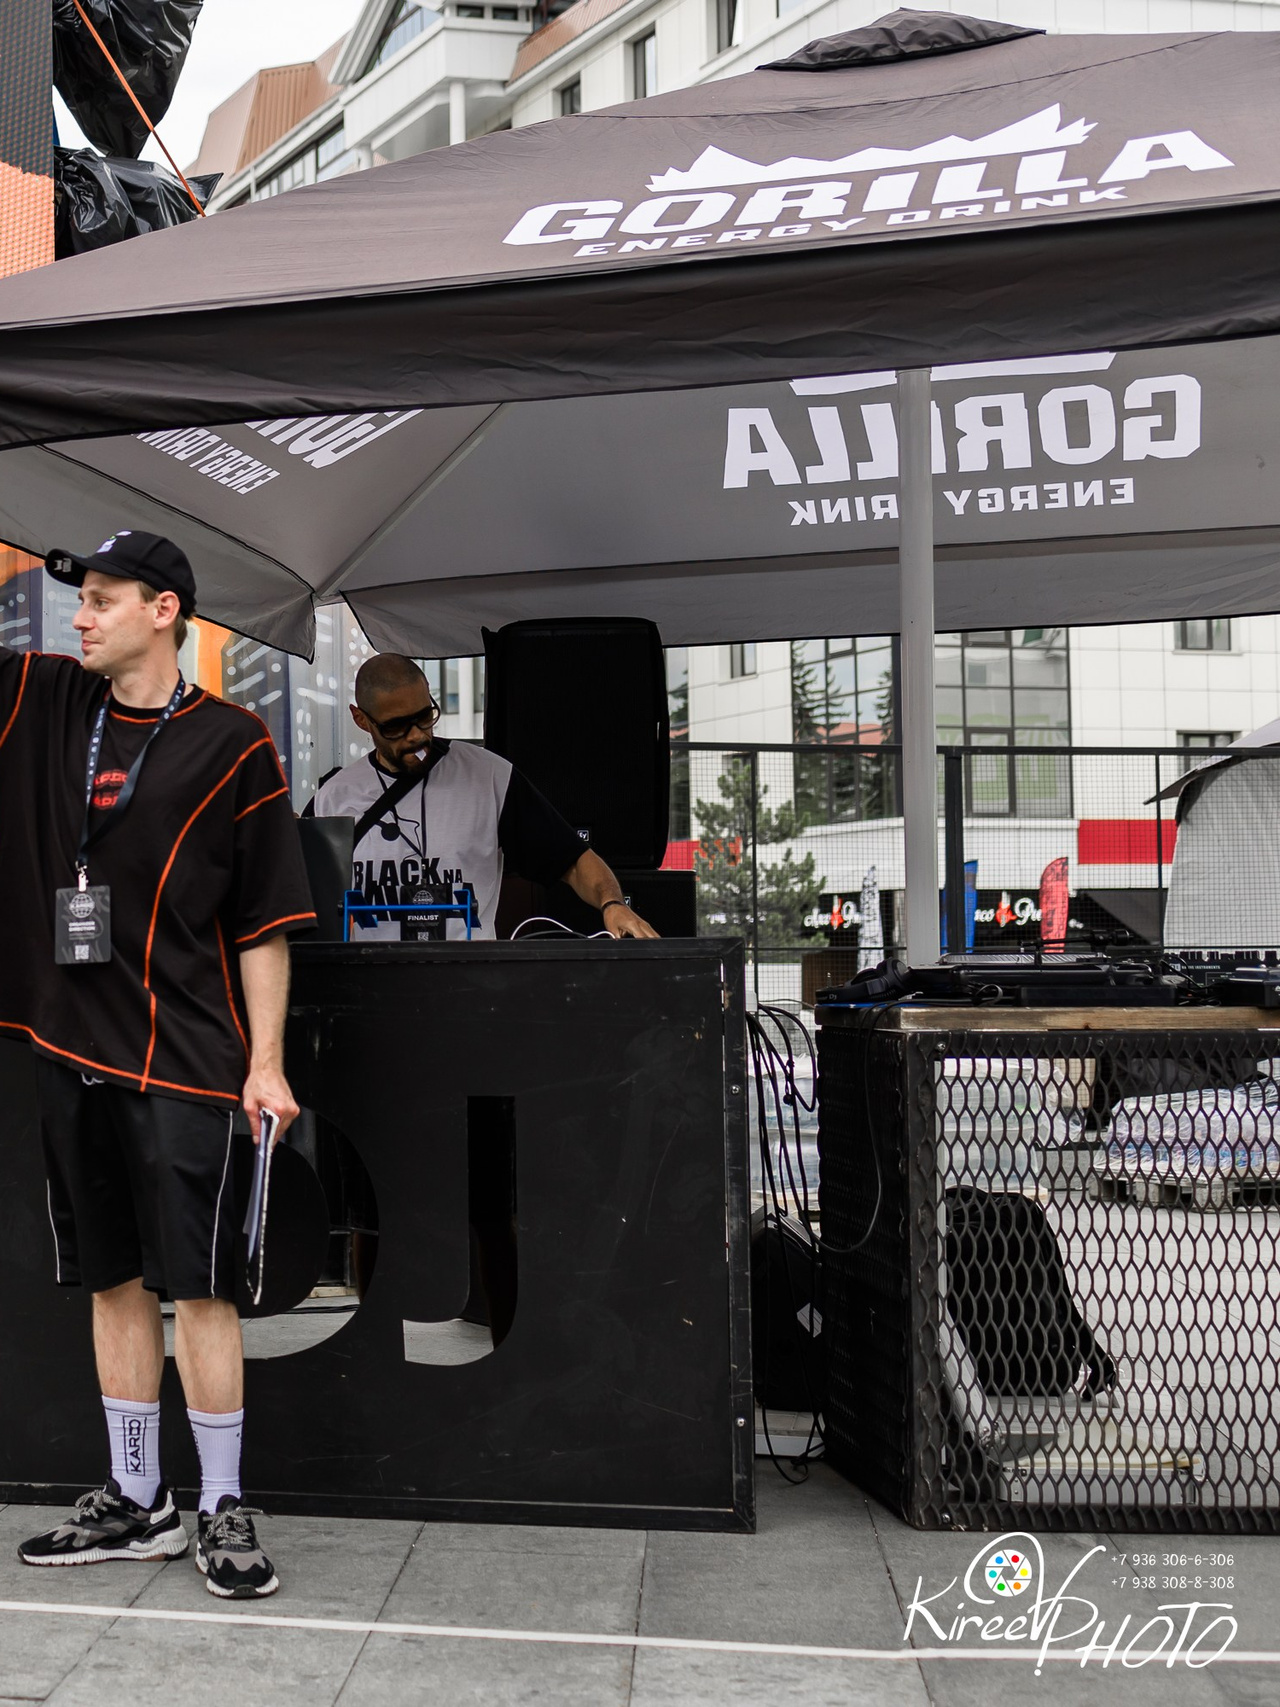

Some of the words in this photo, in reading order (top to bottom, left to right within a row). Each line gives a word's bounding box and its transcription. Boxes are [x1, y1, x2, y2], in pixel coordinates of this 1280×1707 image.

[502, 131, 1235, 246] GORILLA
[573, 217, 866, 258] ENERGY
[886, 186, 1129, 225] DRINK
[353, 857, 441, 888] BLACK
[129, 1418, 142, 1474] KARDO
